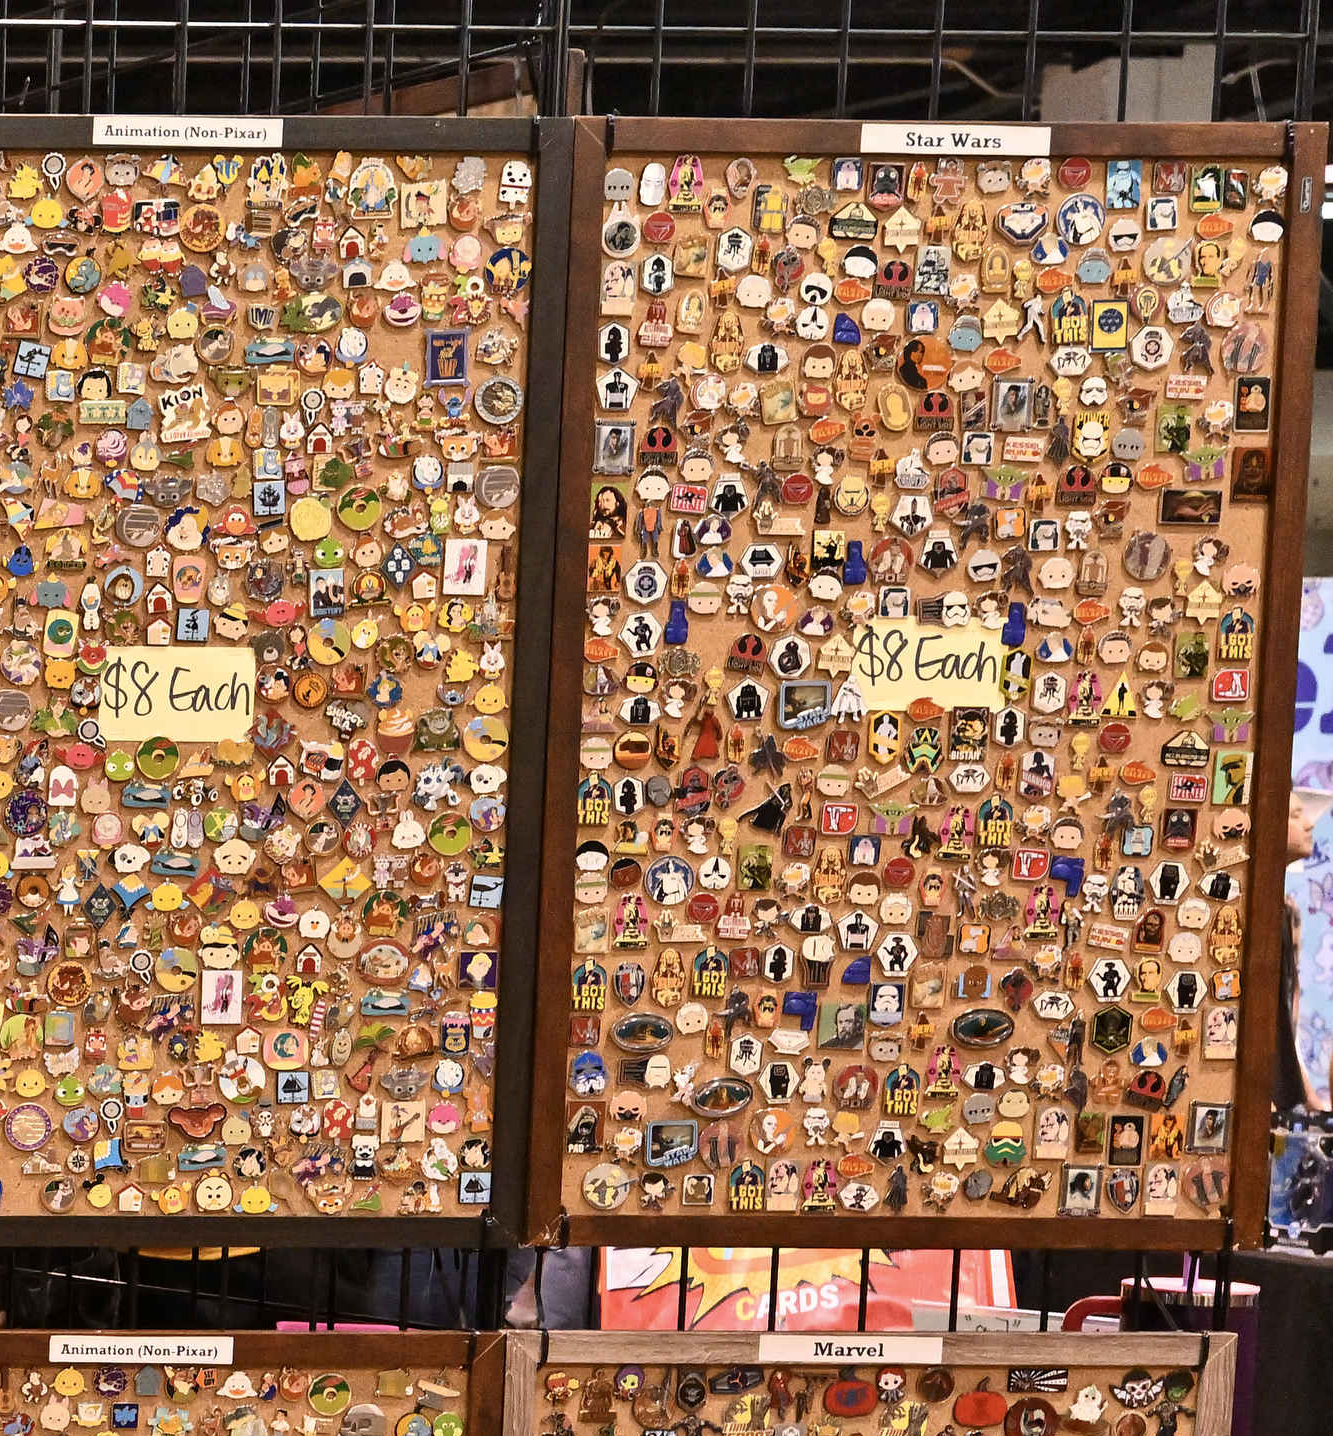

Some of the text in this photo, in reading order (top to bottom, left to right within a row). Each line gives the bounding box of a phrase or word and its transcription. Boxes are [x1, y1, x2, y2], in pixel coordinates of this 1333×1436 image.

[104, 126, 267, 140] Animation (Non-Pixar)
[906, 132, 1001, 147] Star Wars
[1055, 330, 1087, 346] THIS
[161, 386, 203, 411] KION
[855, 624, 998, 686] $8 Each
[104, 656, 250, 718] $8 Each
[579, 811, 610, 824] THIS
[979, 831, 1014, 846] THIS
[574, 996, 606, 1010] THIS
[736, 1284, 840, 1319] CARDS
[62, 1343, 218, 1358] Animation (Non-Pixar)
[814, 1343, 884, 1357] Marvel
